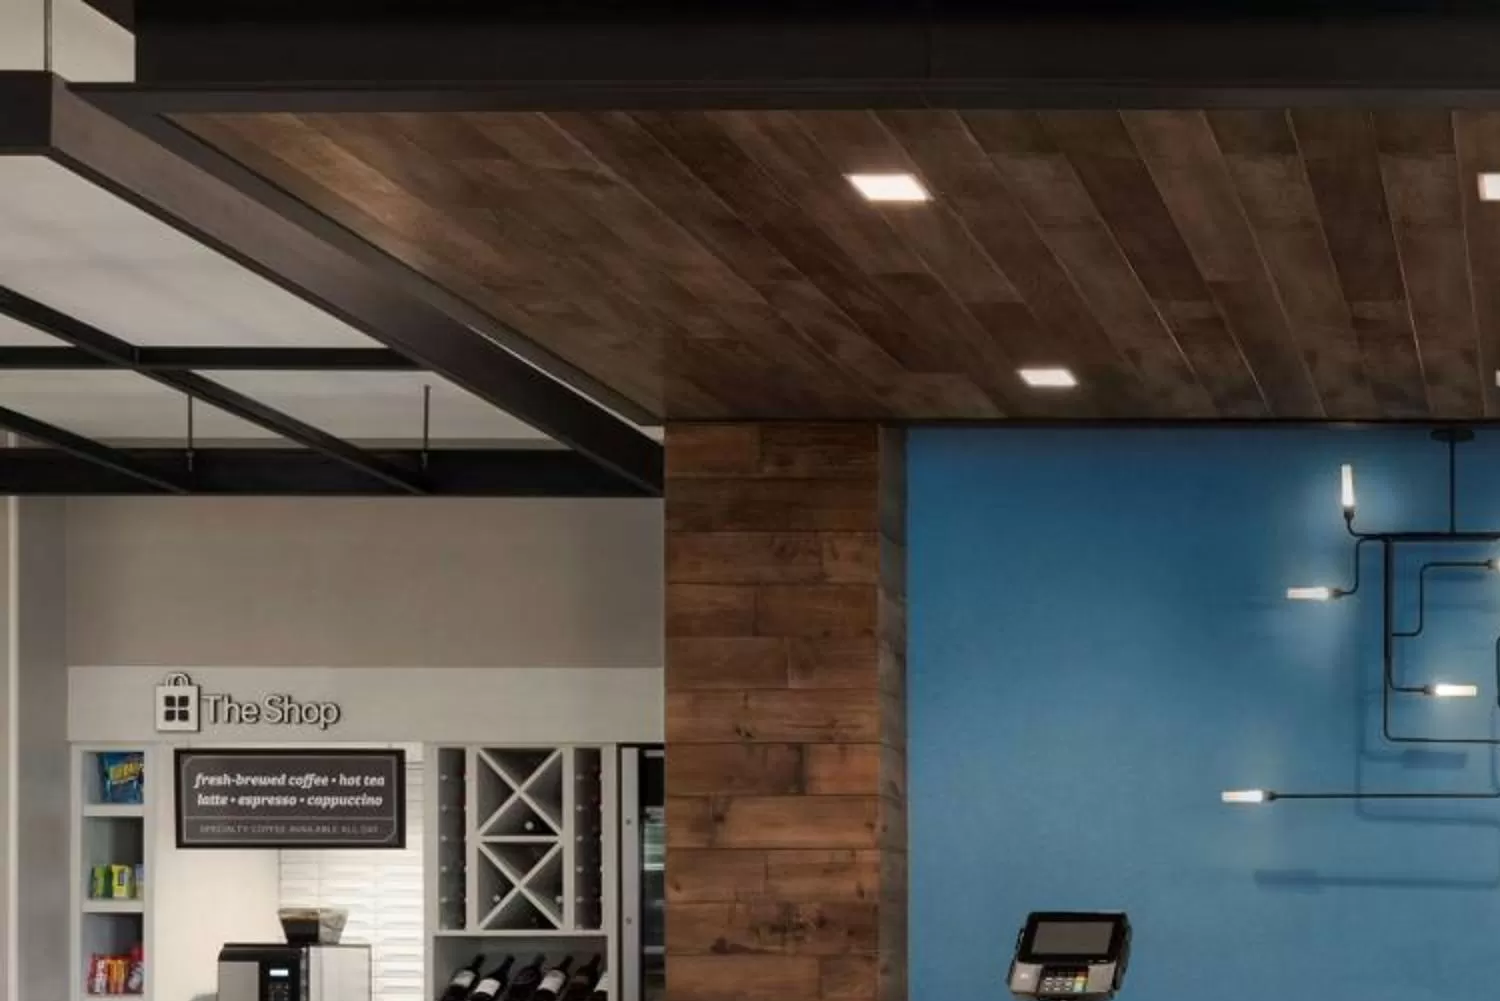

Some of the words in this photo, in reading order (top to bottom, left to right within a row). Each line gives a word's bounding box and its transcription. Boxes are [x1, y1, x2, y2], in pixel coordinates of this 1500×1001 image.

[201, 694, 260, 724] The
[263, 694, 341, 730] Shop
[194, 773, 287, 788] fresh-brewed
[288, 774, 329, 788] coffee
[338, 774, 361, 787] hot
[364, 775, 385, 787] tea
[197, 794, 229, 806] latte
[237, 796, 297, 809] espresso
[307, 794, 383, 809] cappuccino
